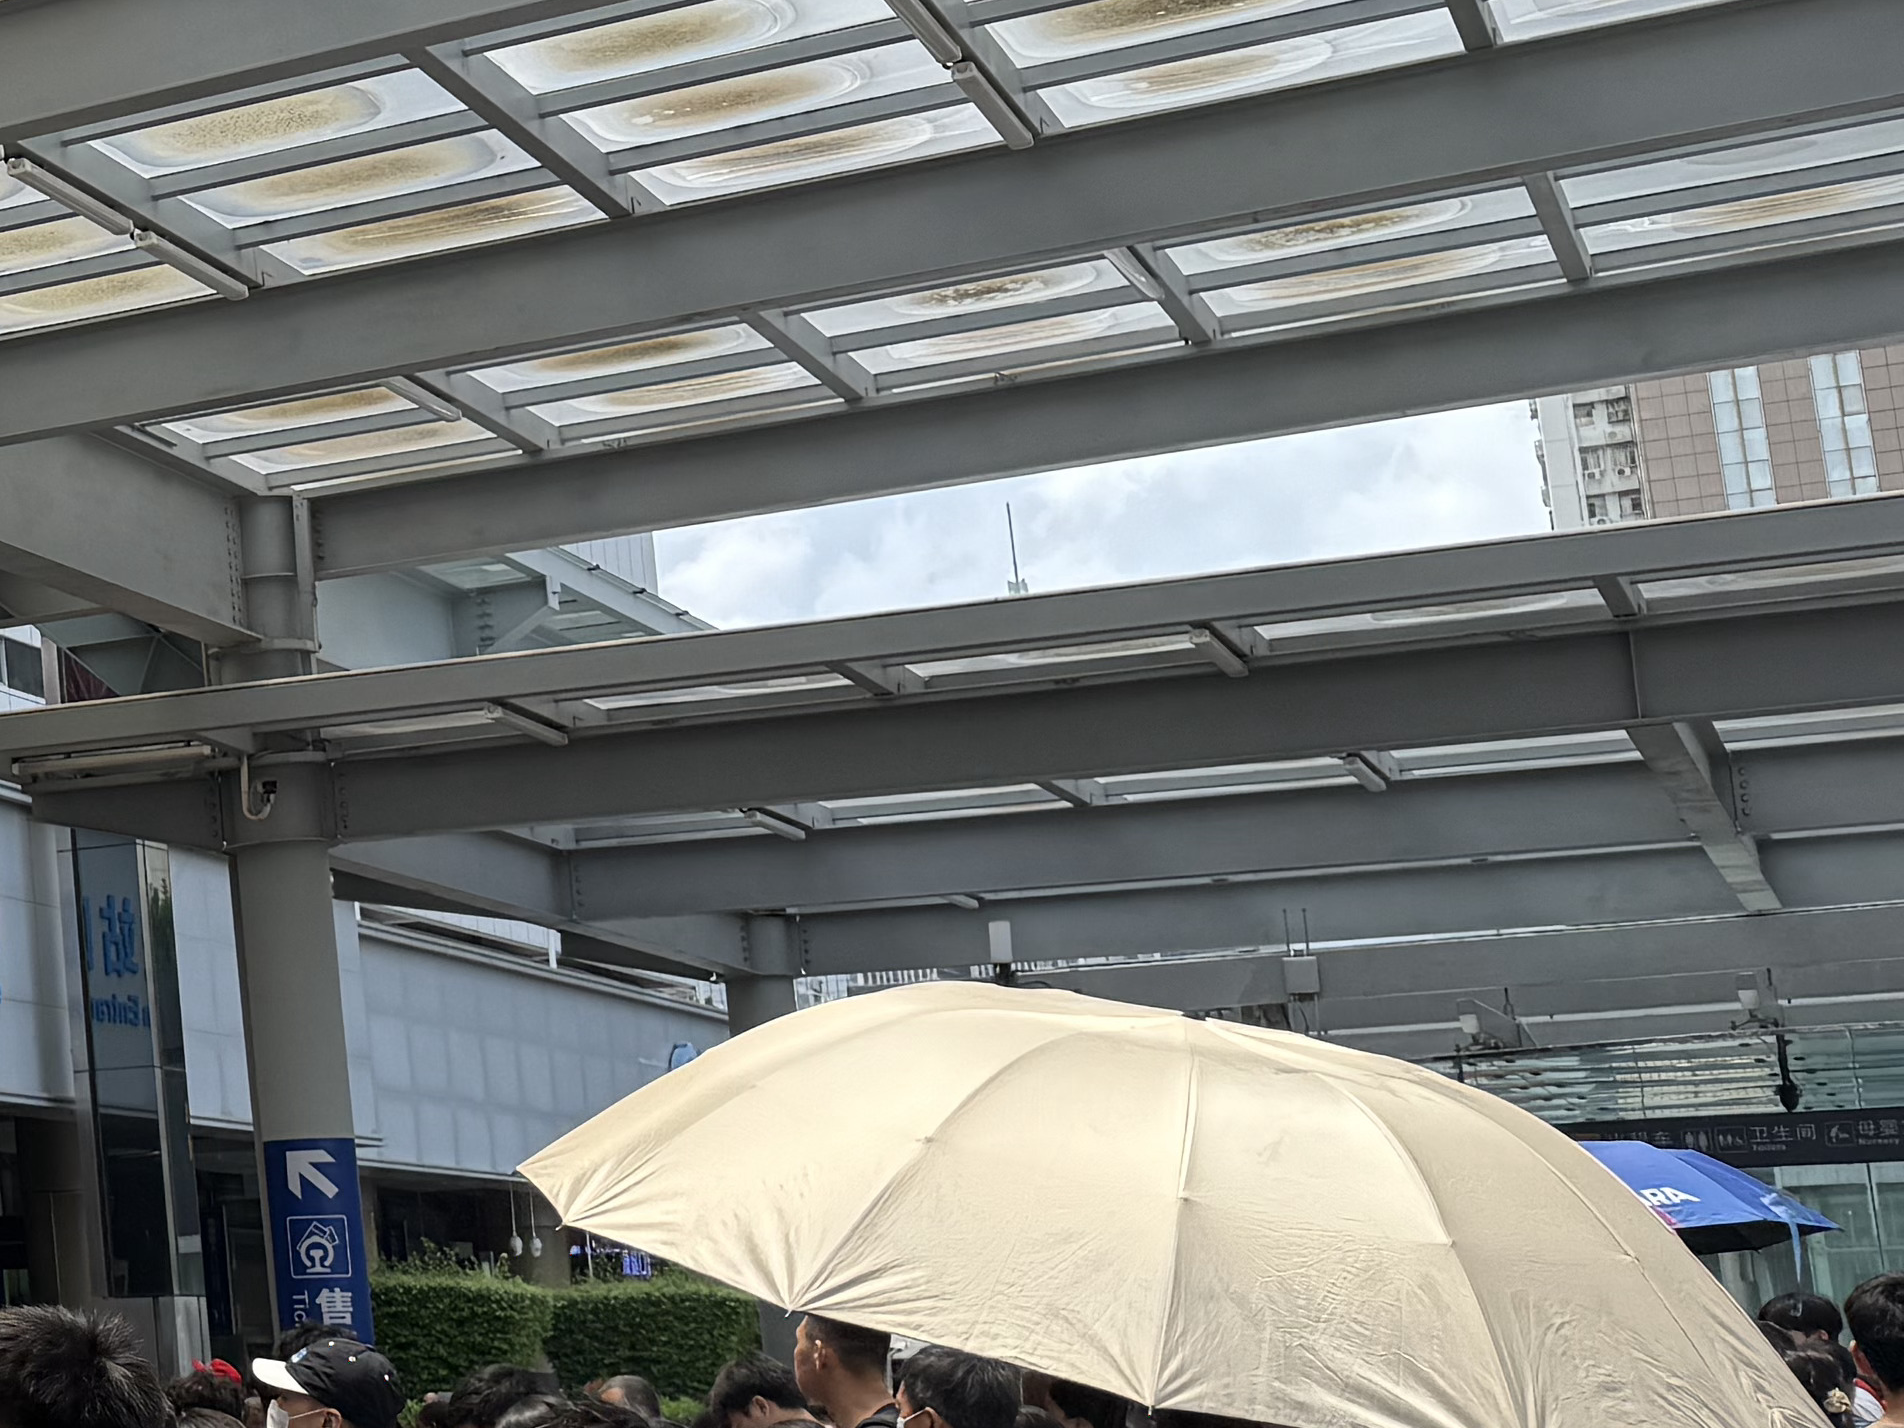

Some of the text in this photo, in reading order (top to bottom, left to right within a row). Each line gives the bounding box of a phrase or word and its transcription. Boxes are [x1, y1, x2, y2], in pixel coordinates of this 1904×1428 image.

[1749, 1123, 1817, 1142] 卫生间
[1858, 1118, 1904, 1137] 母婴
[315, 1287, 354, 1326] 售
